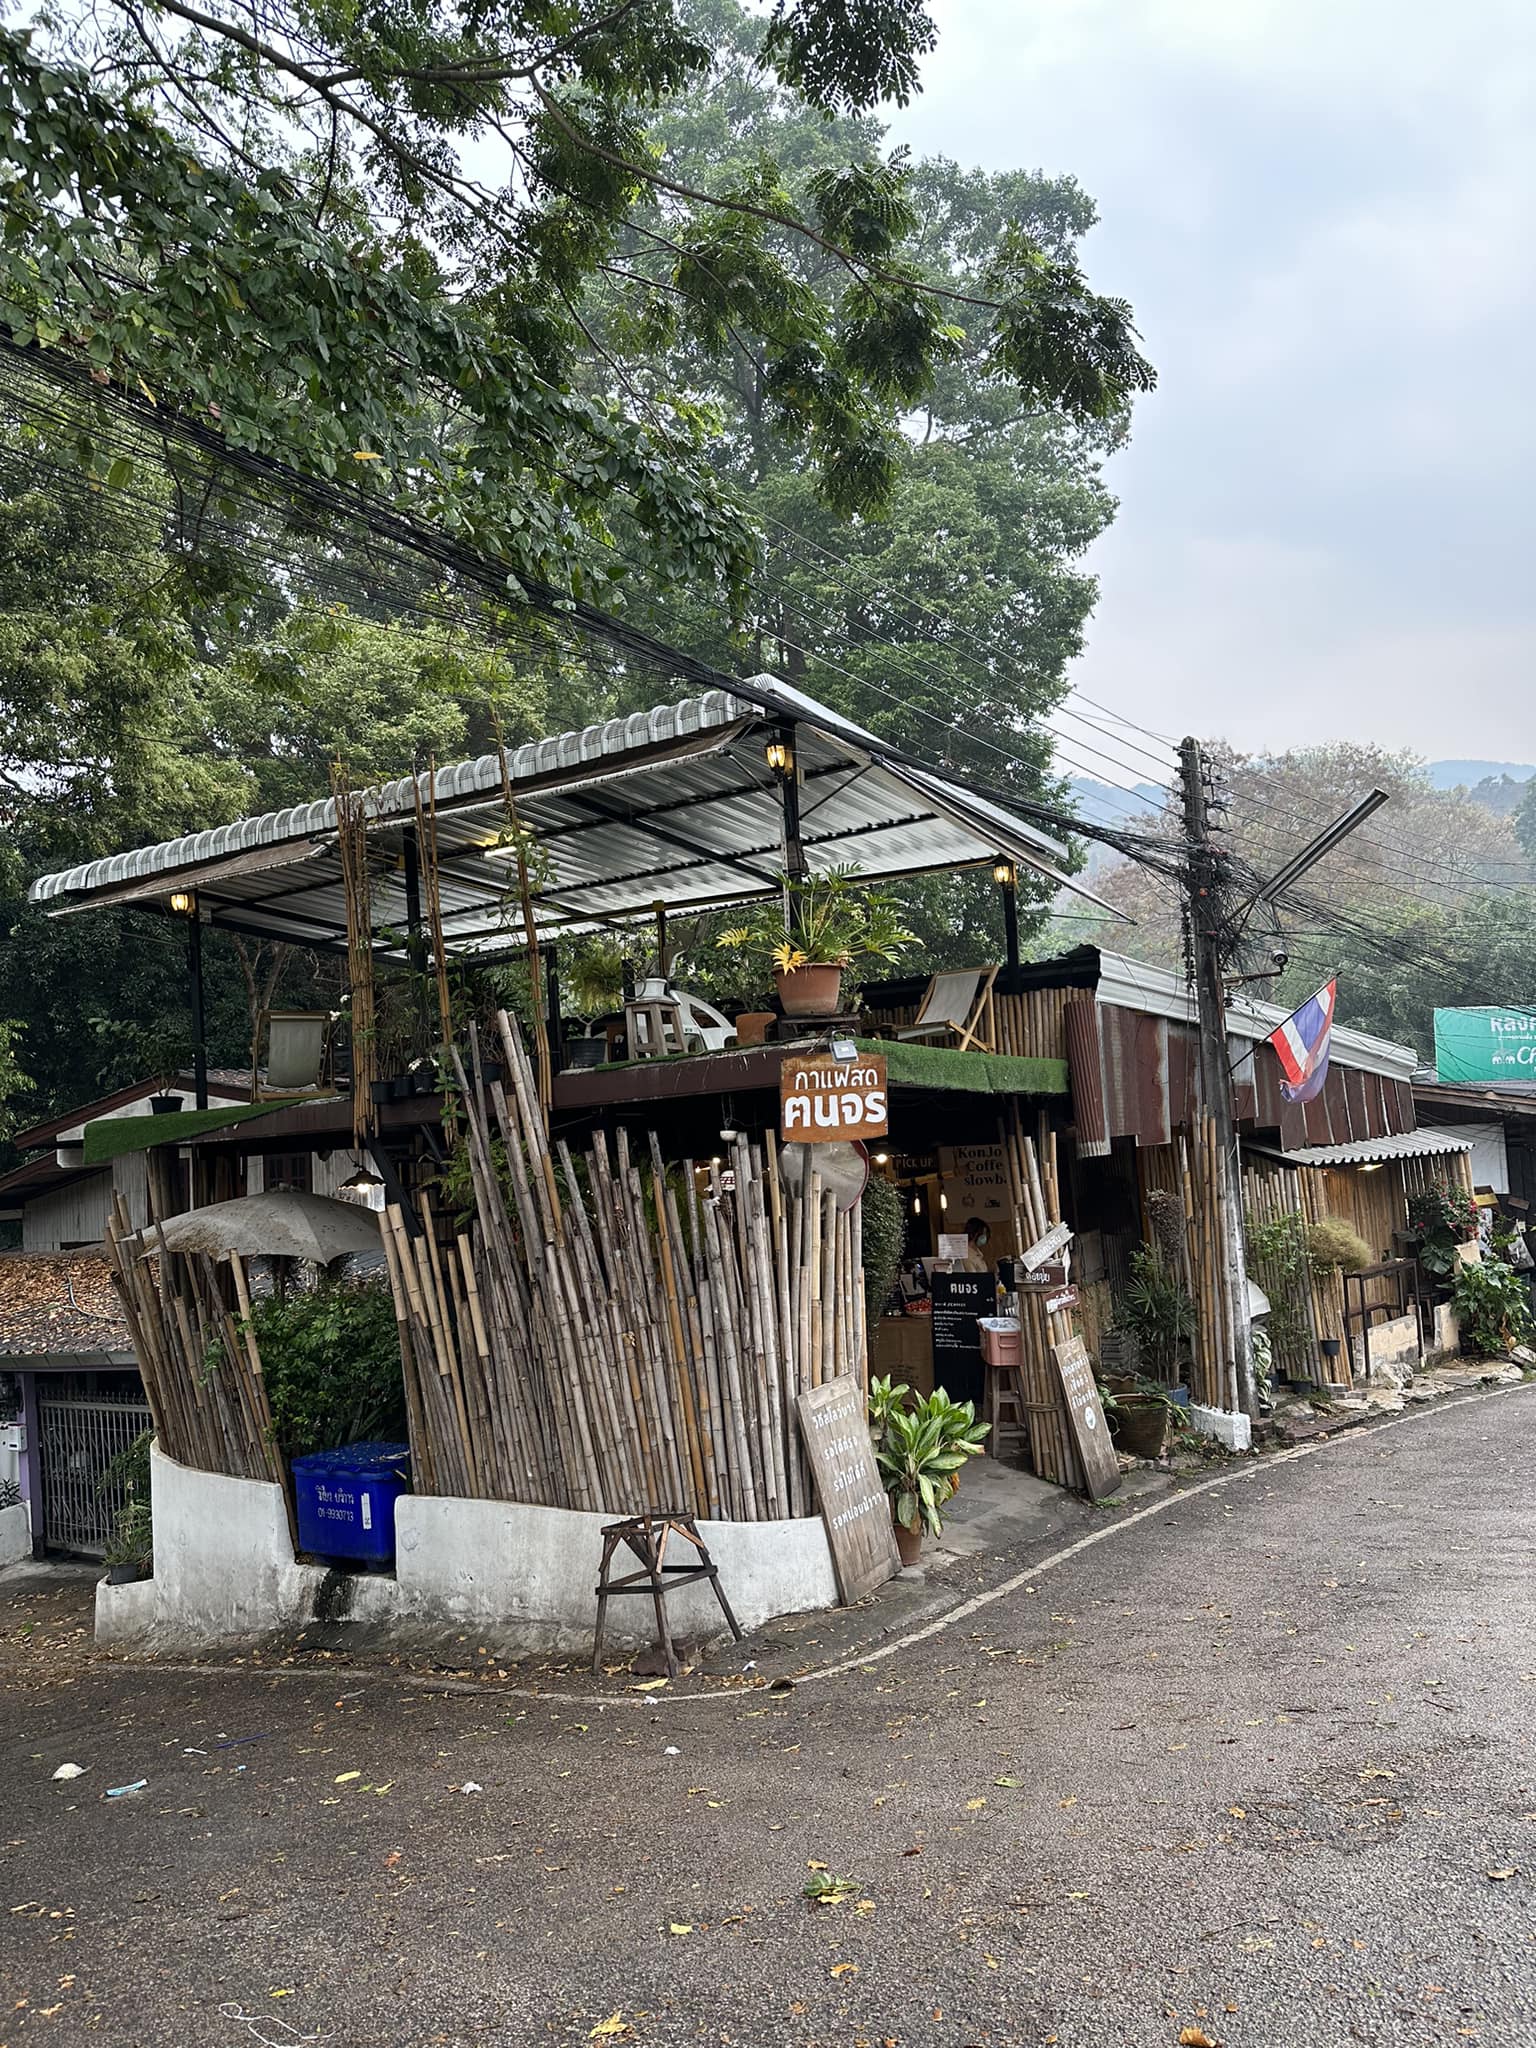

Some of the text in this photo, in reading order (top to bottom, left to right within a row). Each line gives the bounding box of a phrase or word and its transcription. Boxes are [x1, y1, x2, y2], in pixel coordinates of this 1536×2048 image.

[795, 1064, 878, 1090] กาแฟสด
[959, 1147, 1002, 1159] KonJo
[967, 1160, 1003, 1172] Coffe
[964, 1174, 1007, 1185] slowb
